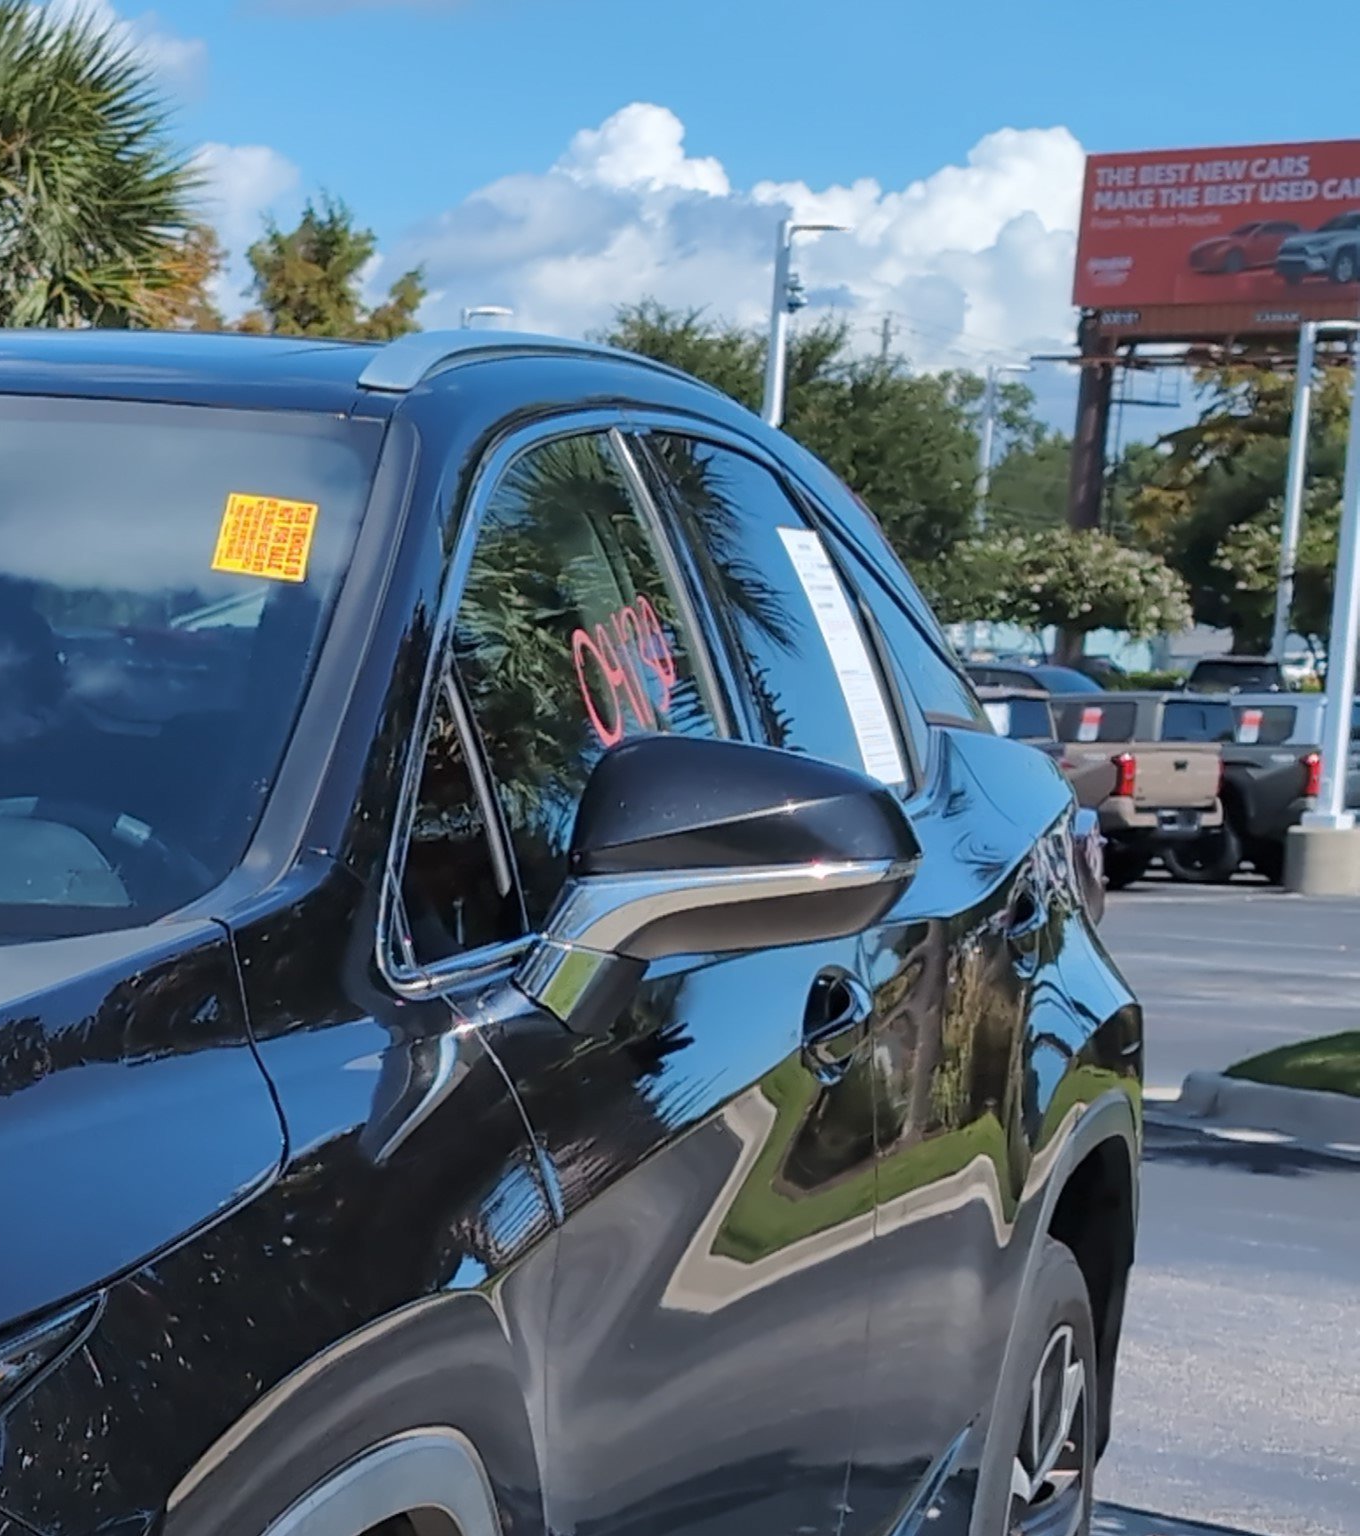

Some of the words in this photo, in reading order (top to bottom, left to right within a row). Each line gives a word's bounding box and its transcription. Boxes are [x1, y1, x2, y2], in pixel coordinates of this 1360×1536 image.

[1096, 166, 1136, 187] THE
[1139, 164, 1191, 185] BEST
[1193, 160, 1248, 183] NEW
[1250, 156, 1309, 179] CARS
[1093, 188, 1156, 211] MAKE
[1159, 187, 1200, 208] THE
[1203, 184, 1255, 205] BEST
[1259, 180, 1319, 203] USED
